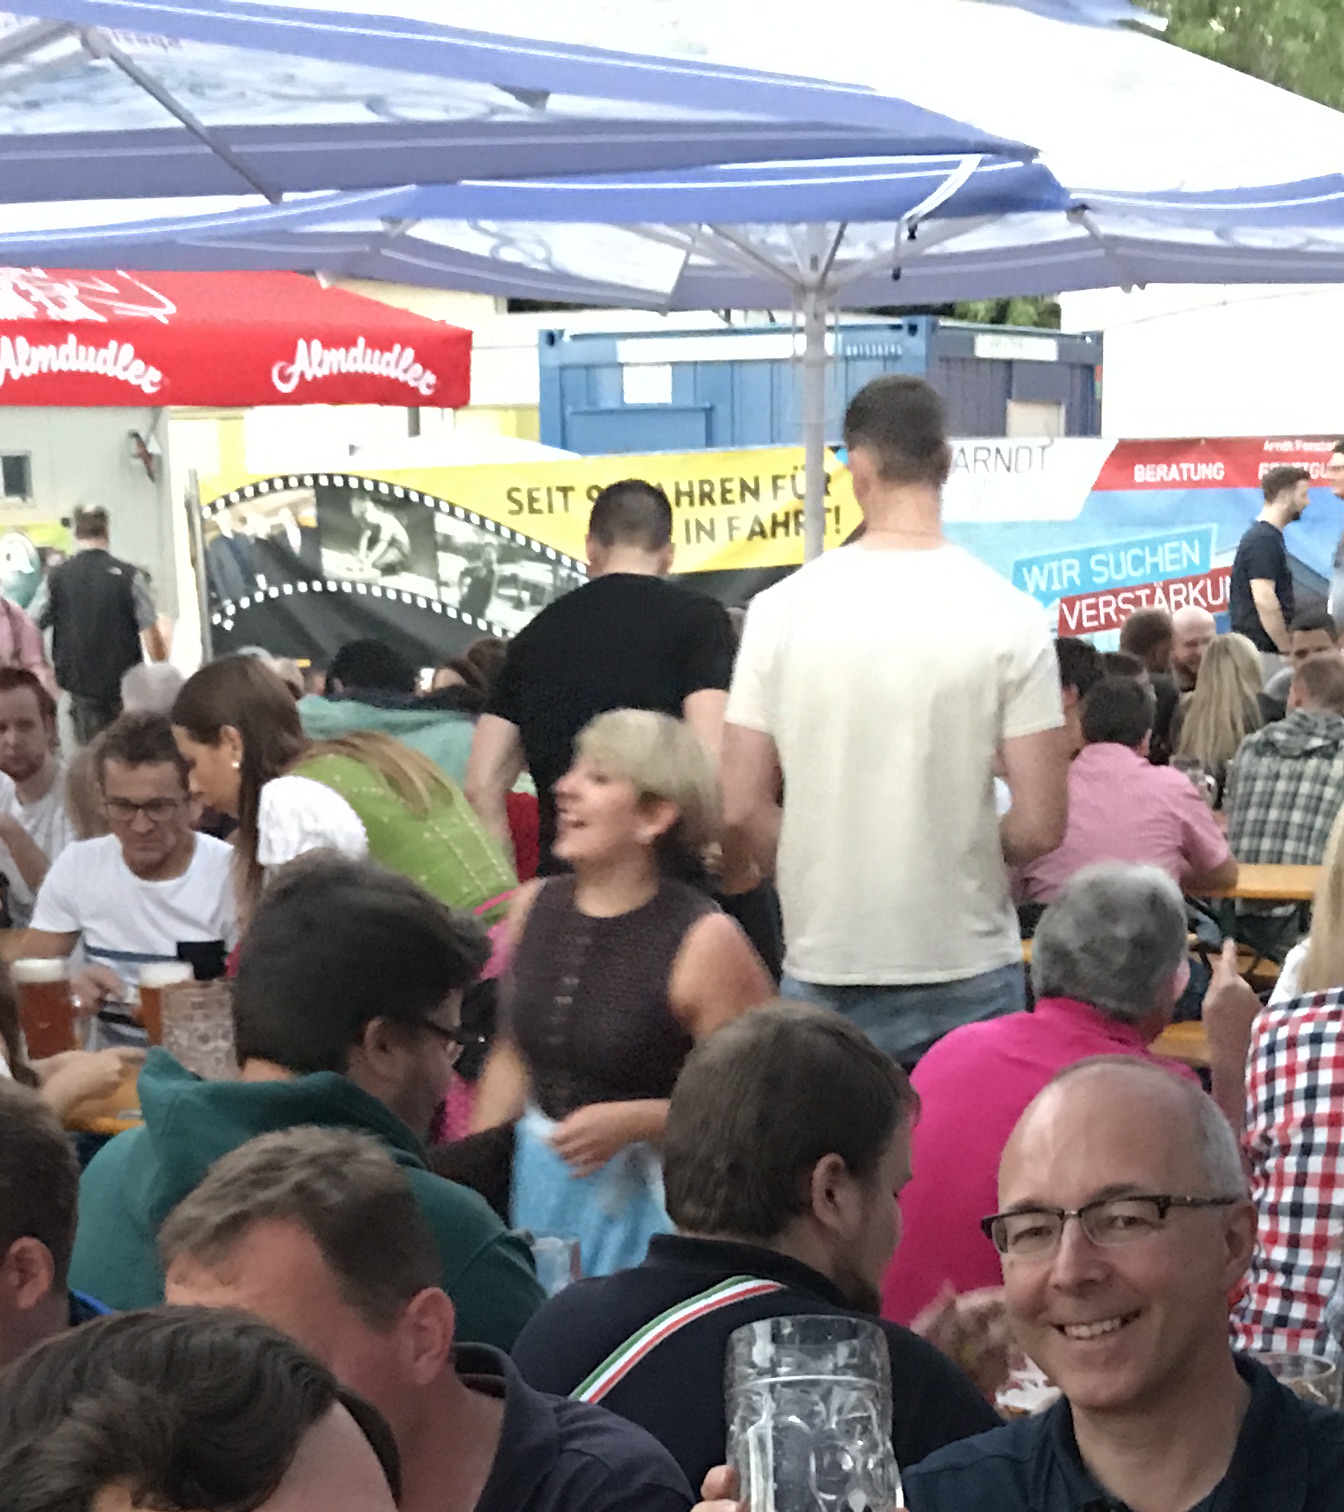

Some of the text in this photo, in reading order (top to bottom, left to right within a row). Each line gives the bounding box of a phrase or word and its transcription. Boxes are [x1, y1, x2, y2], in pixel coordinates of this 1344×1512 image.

[271, 336, 438, 396] Almdudler
[1134, 461, 1225, 483] BERATUNG
[506, 485, 575, 516] SEIT
[684, 517, 716, 545] IN
[1022, 539, 1201, 594] WIR SUCHEN
